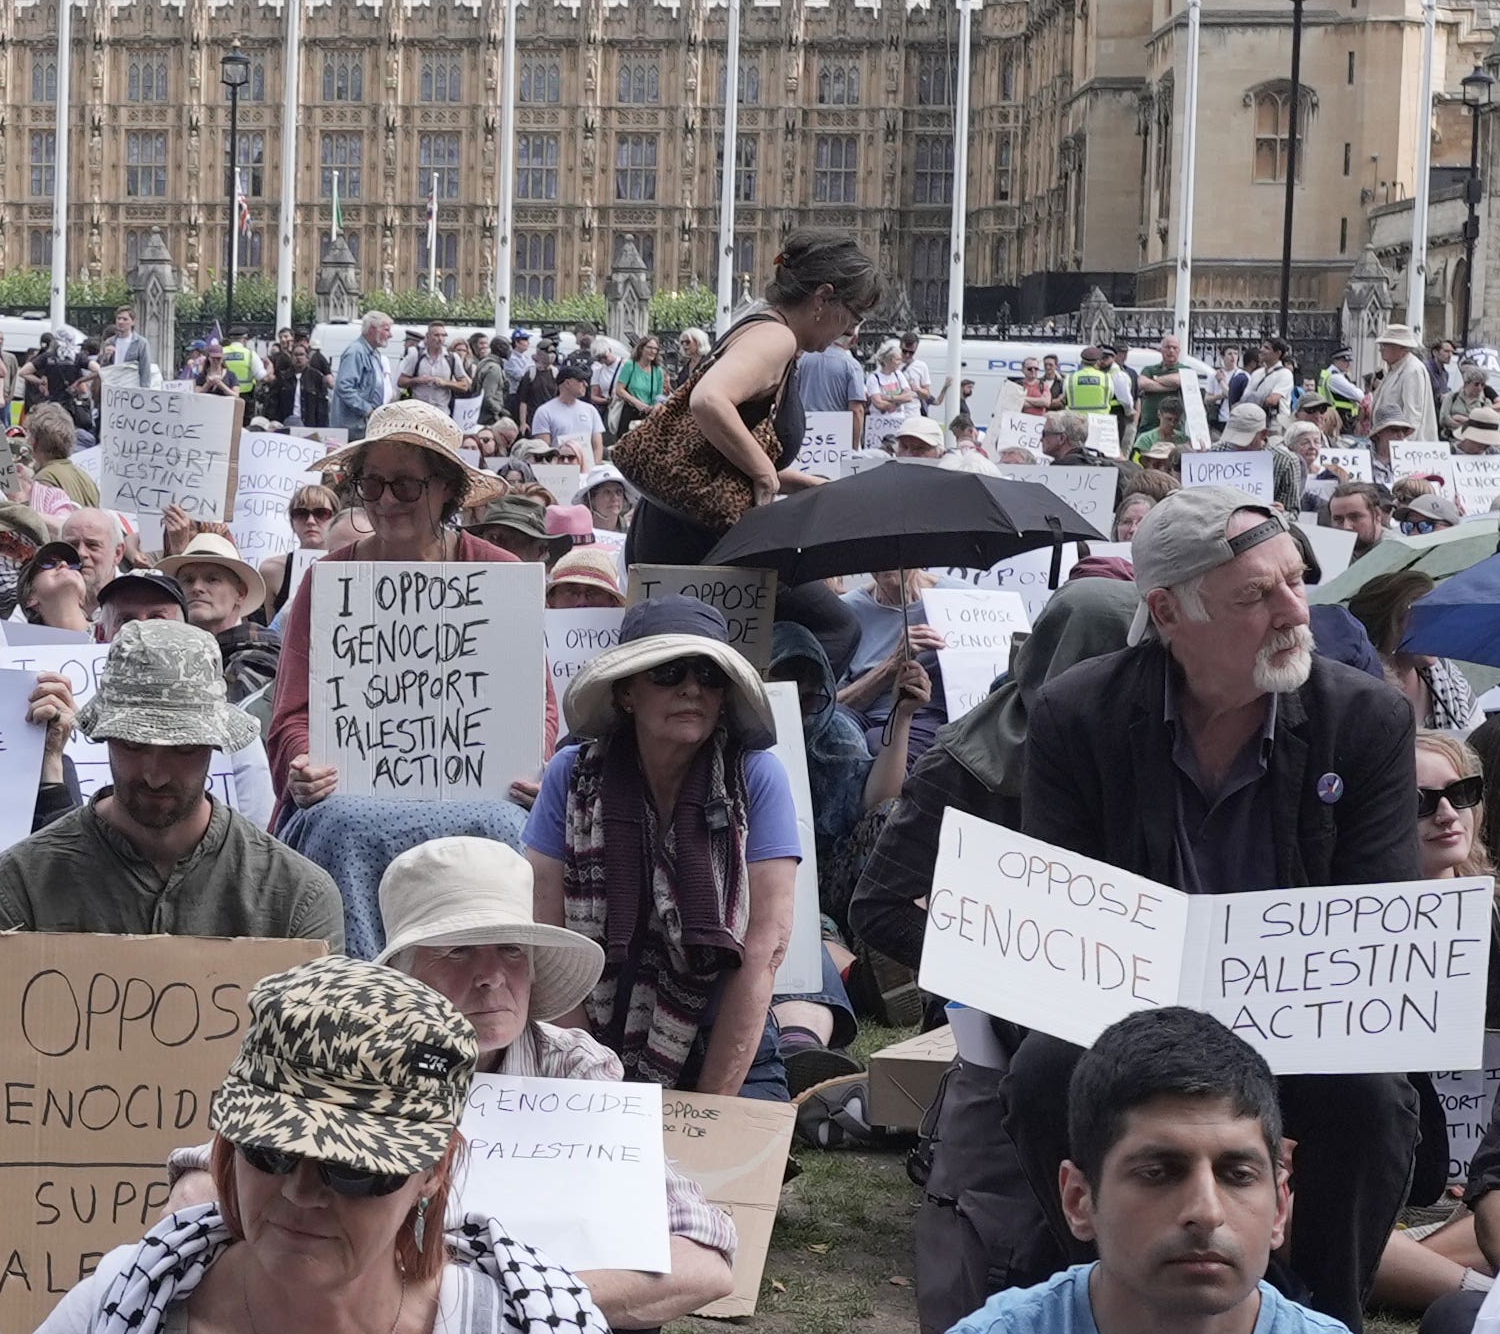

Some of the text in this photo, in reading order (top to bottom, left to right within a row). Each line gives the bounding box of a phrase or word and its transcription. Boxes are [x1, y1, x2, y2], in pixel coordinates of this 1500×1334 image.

[106, 390, 182, 415] OPPOSE
[108, 414, 204, 439] GENOCIDE
[251, 438, 322, 463] OPPOSE
[1198, 461, 1253, 480] OPPOSE
[115, 482, 217, 514] ACTION
[337, 570, 488, 618] I OPPOSE
[332, 618, 490, 665] GENOCIDE
[326, 670, 489, 711] I SUPPORT
[335, 707, 491, 761] PALESTINE
[372, 750, 485, 789] ACTION
[997, 850, 1162, 931] OPPOSE
[1261, 887, 1488, 937] SUPPORT
[929, 888, 1161, 1004] GENOCIDE
[1222, 938, 1480, 999] PALESTINE
[21, 969, 241, 1057] OPPOS
[1230, 990, 1438, 1041] ACTION
[468, 1138, 641, 1162] PALESTINE
